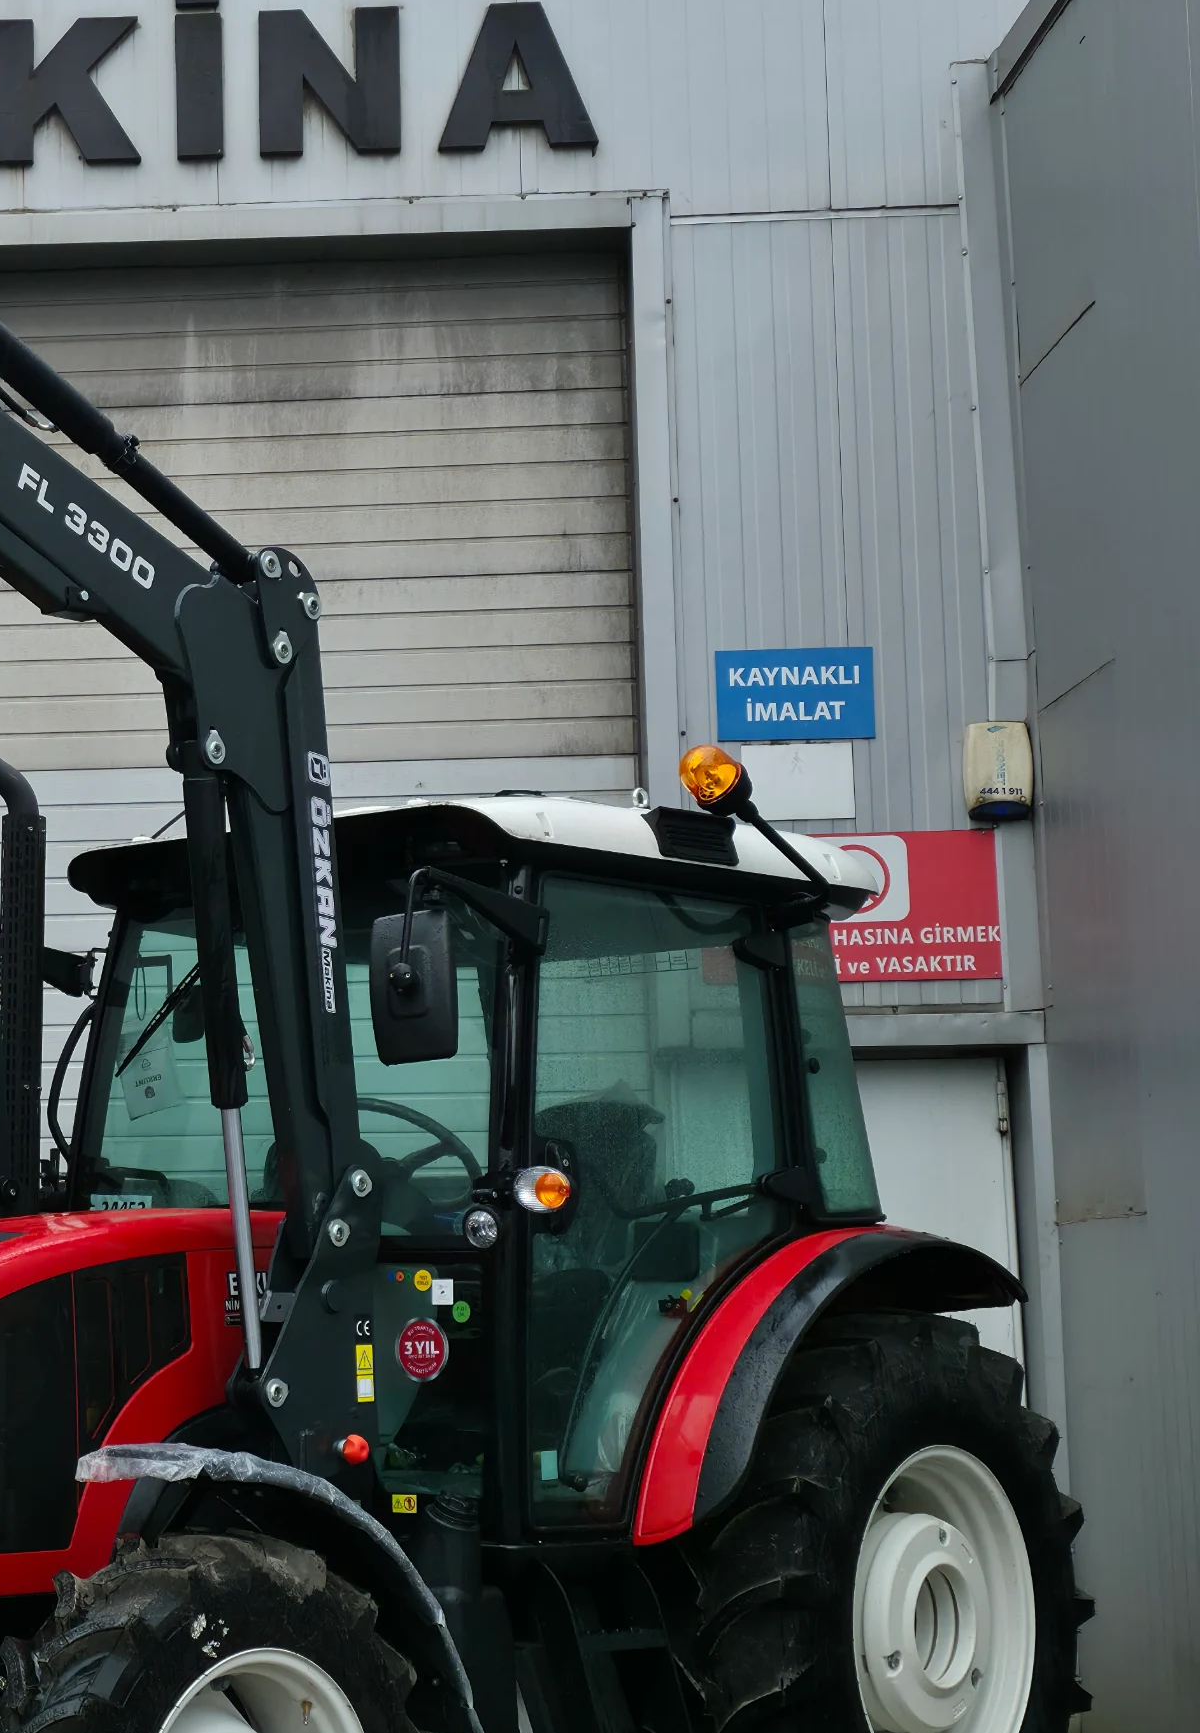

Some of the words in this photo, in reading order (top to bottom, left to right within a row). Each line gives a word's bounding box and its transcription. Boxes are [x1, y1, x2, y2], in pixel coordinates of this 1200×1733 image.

[17, 463, 55, 514] FL
[64, 502, 156, 590] 3300
[728, 665, 861, 687] KAYNAKLI
[746, 698, 846, 723] İMALAT
[979, 787, 1000, 795] 444
[1002, 787, 1006, 795] 1
[1009, 787, 1023, 796] 911
[310, 795, 338, 948] ÖZKAN
[834, 926, 913, 946] HASINA
[920, 923, 1001, 944] GİRMEK
[847, 962, 870, 974] ve
[875, 955, 978, 974] YASAKTIR
[322, 948, 336, 1012] Makina
[404, 1341, 413, 1355] 3
[414, 1340, 440, 1355] YIL
